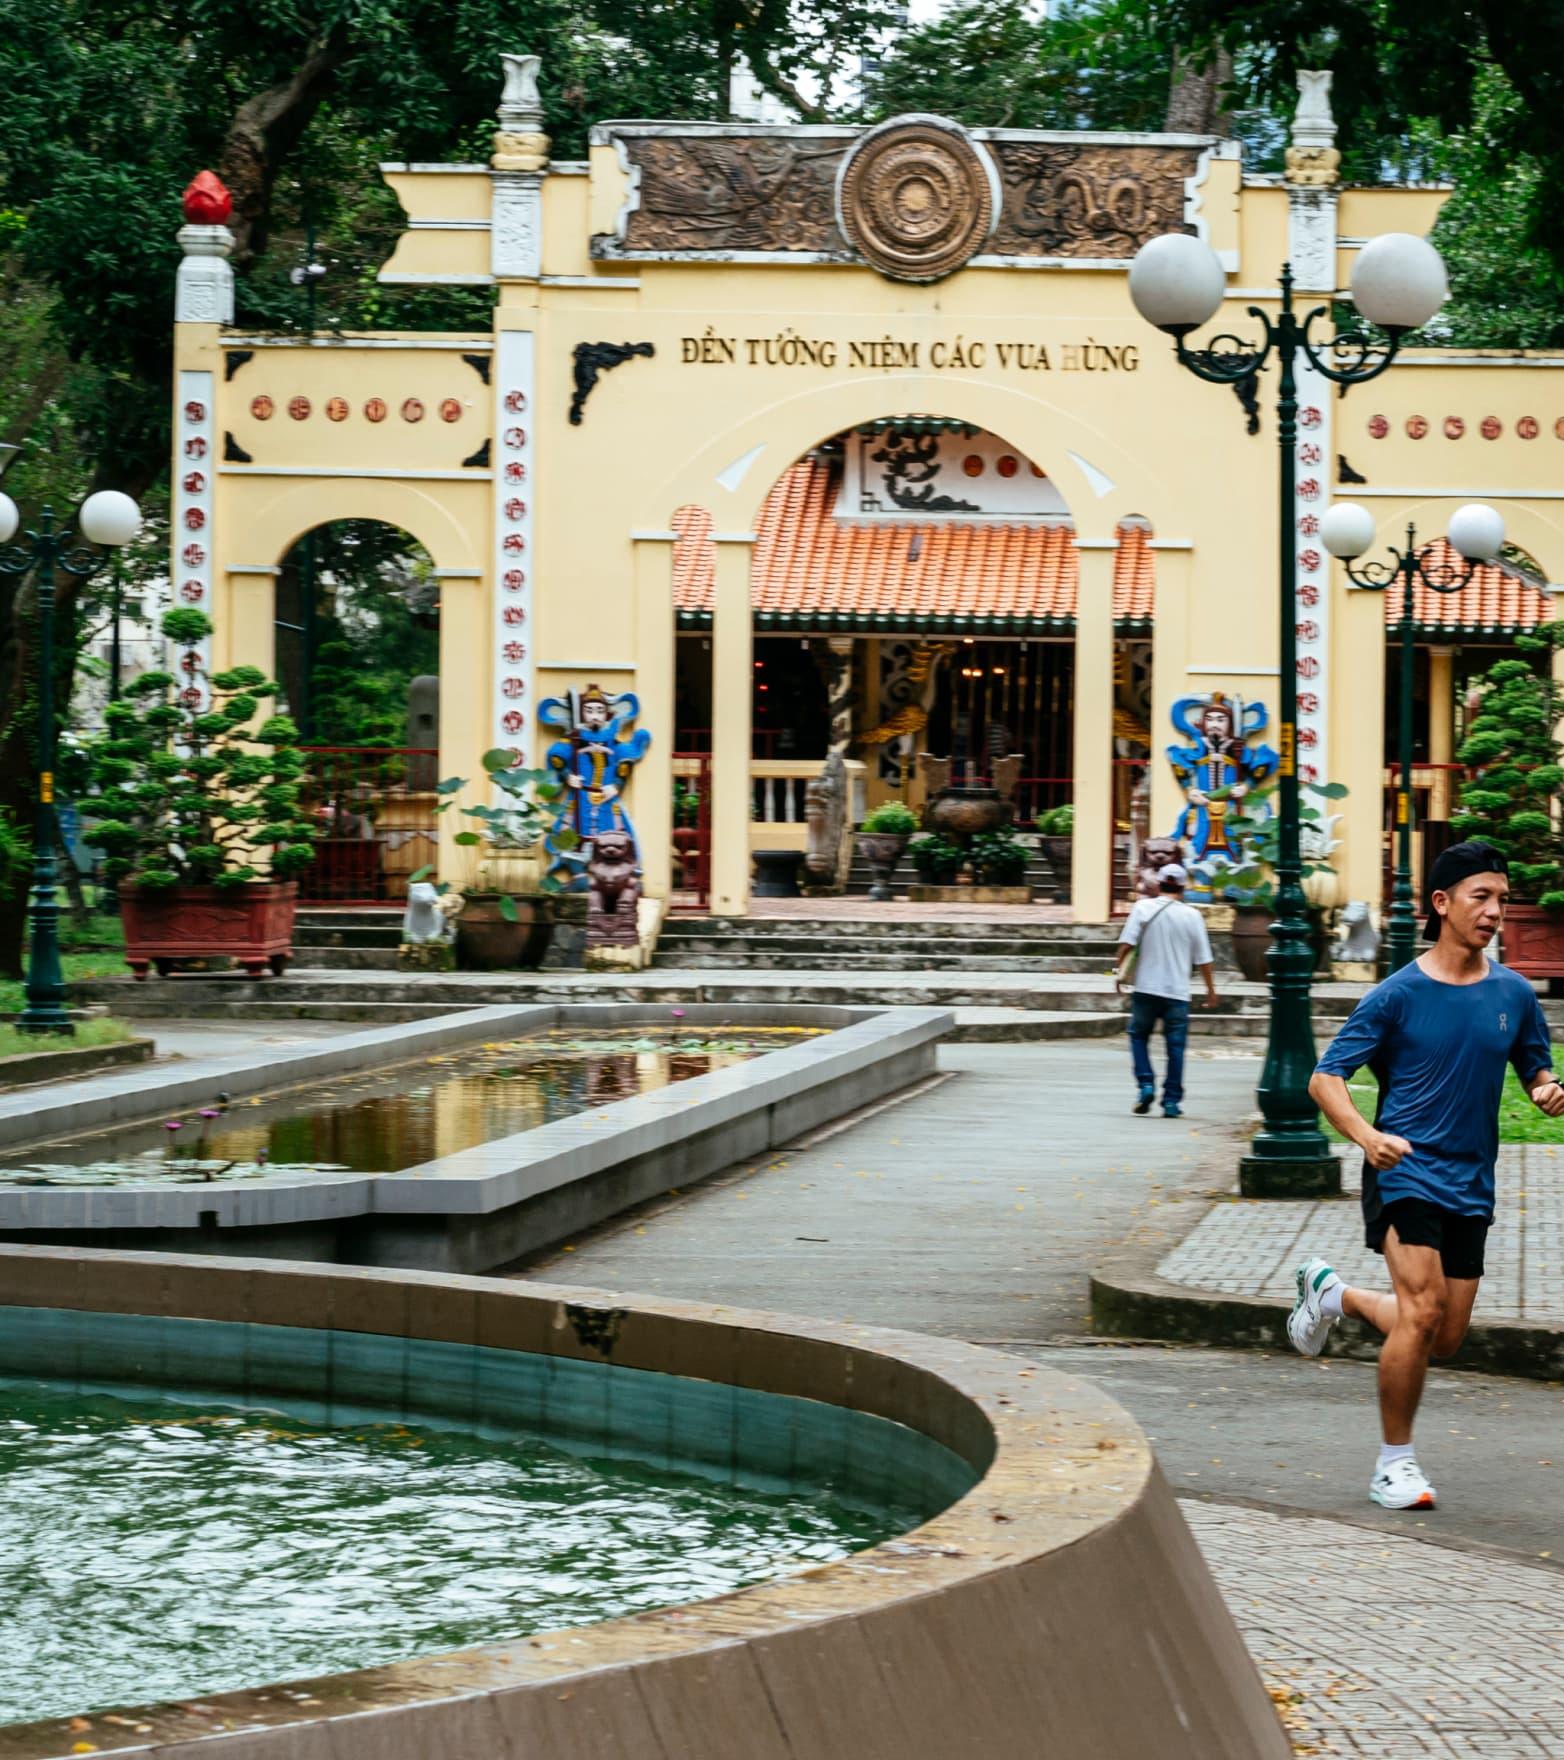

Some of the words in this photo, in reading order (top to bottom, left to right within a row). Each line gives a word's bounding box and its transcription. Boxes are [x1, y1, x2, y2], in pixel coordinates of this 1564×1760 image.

[681, 325, 736, 364] ĐỀN
[745, 327, 837, 368] TƯỞNG
[848, 334, 920, 373] NIỆM
[930, 334, 985, 369] CÁC
[995, 343, 1051, 370] VUA
[1061, 337, 1139, 371] HÙNG
